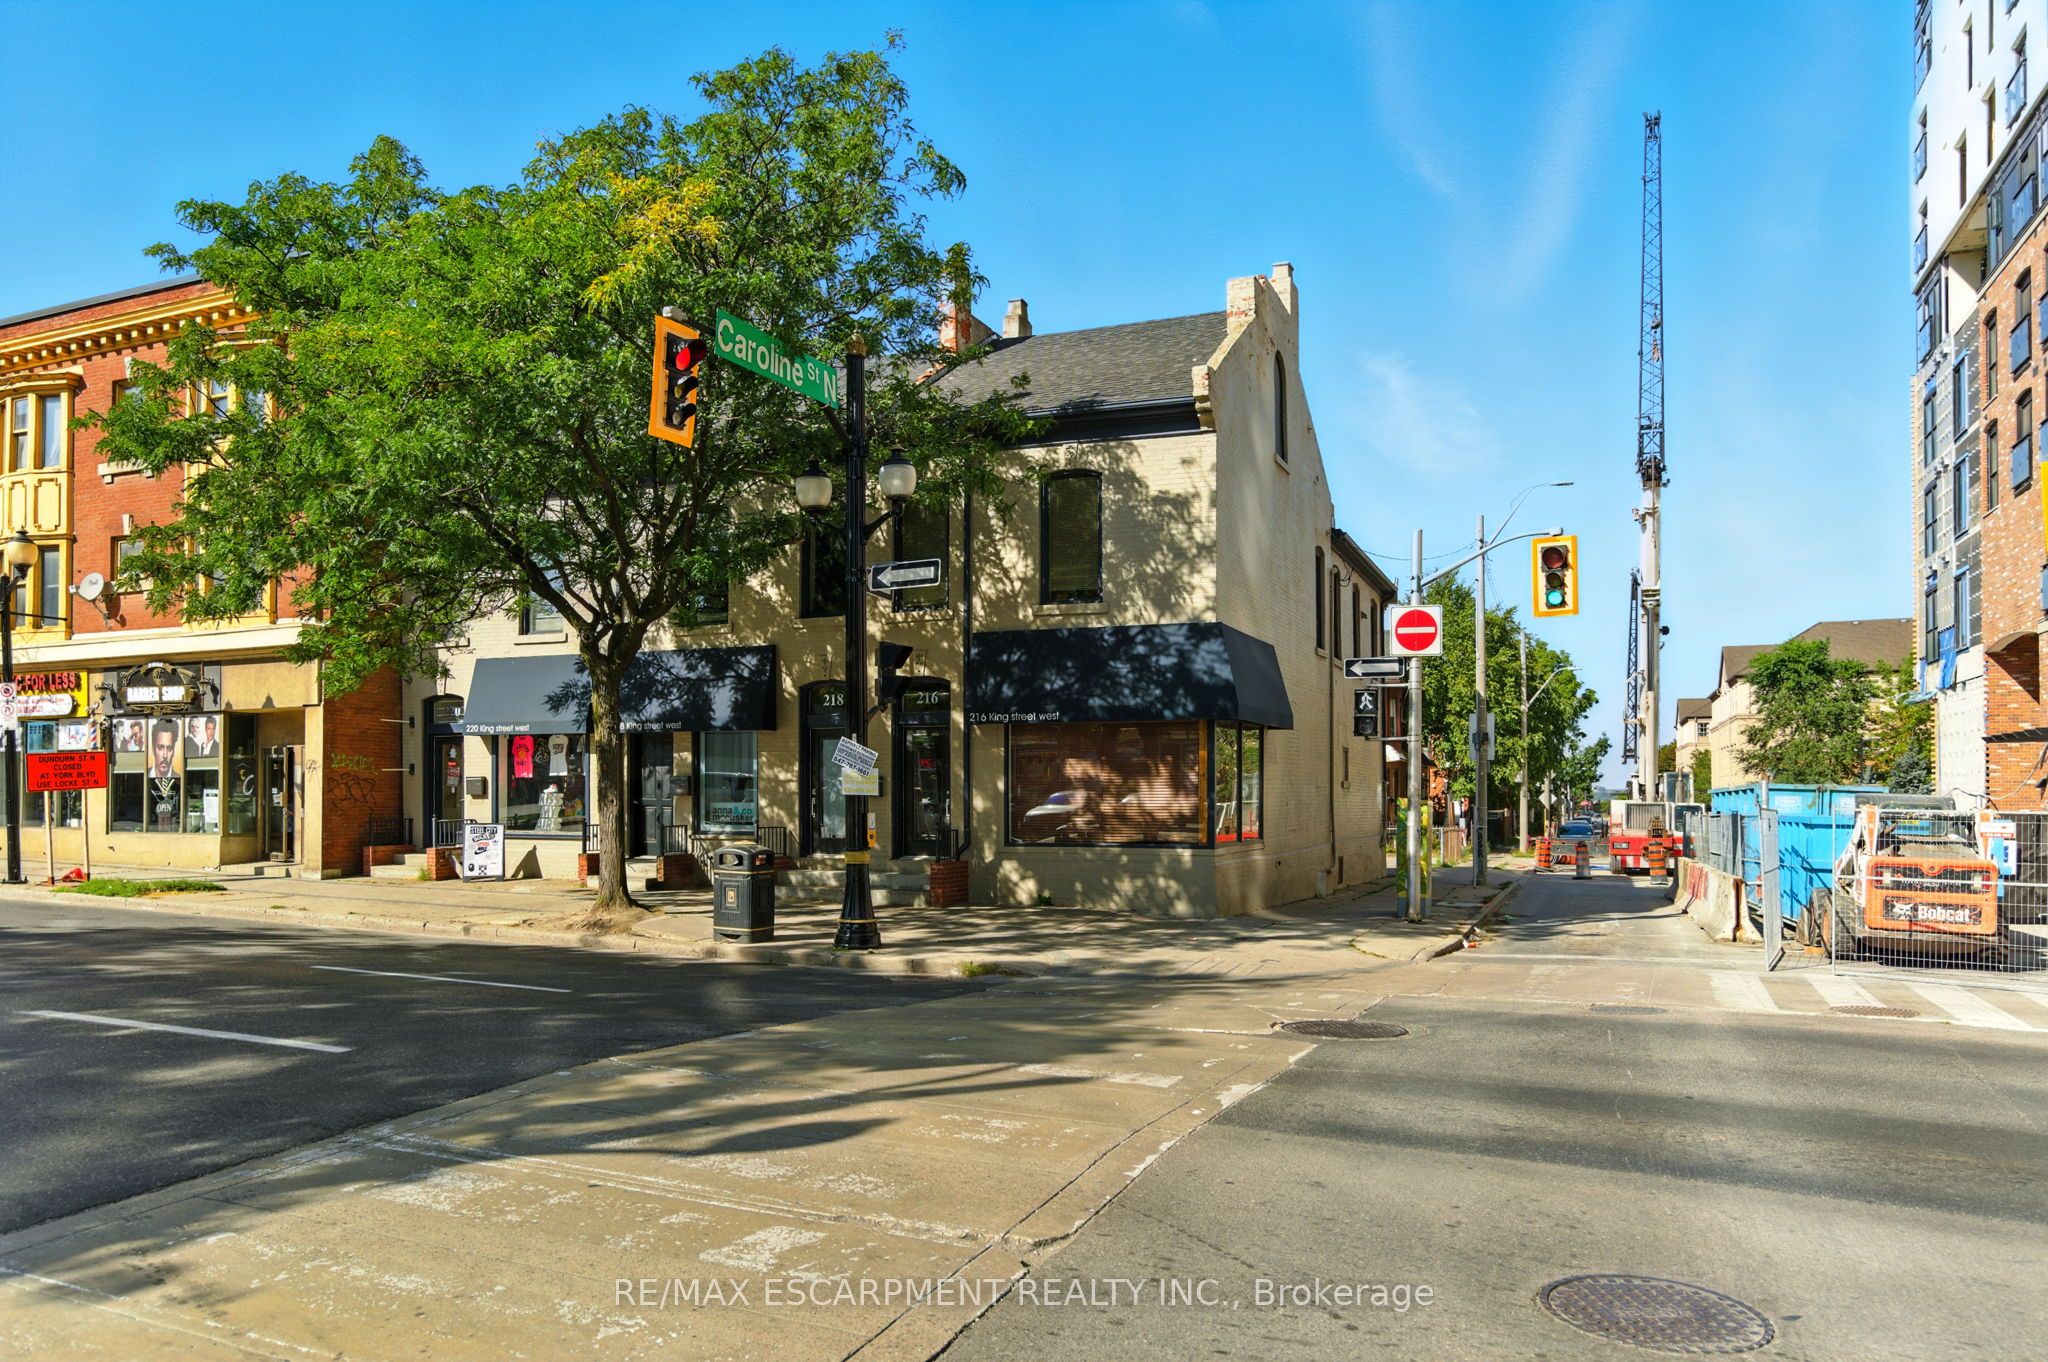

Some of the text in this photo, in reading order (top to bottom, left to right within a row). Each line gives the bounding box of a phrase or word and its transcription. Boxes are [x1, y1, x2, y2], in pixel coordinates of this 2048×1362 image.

[718, 319, 836, 402] Caroline St N
[25, 674, 46, 690] FOR
[49, 672, 76, 690] LESS
[823, 694, 844, 706] 218
[916, 692, 939, 704] 216
[969, 711, 1060, 722] 216 King street west
[466, 724, 530, 734] 220 King street west
[626, 722, 642, 732] King
[644, 722, 663, 730] street
[664, 721, 682, 730] west
[55, 780, 78, 788] LOCKE
[156, 803, 172, 812] OPEN
[1918, 905, 1970, 922] Bobcat
